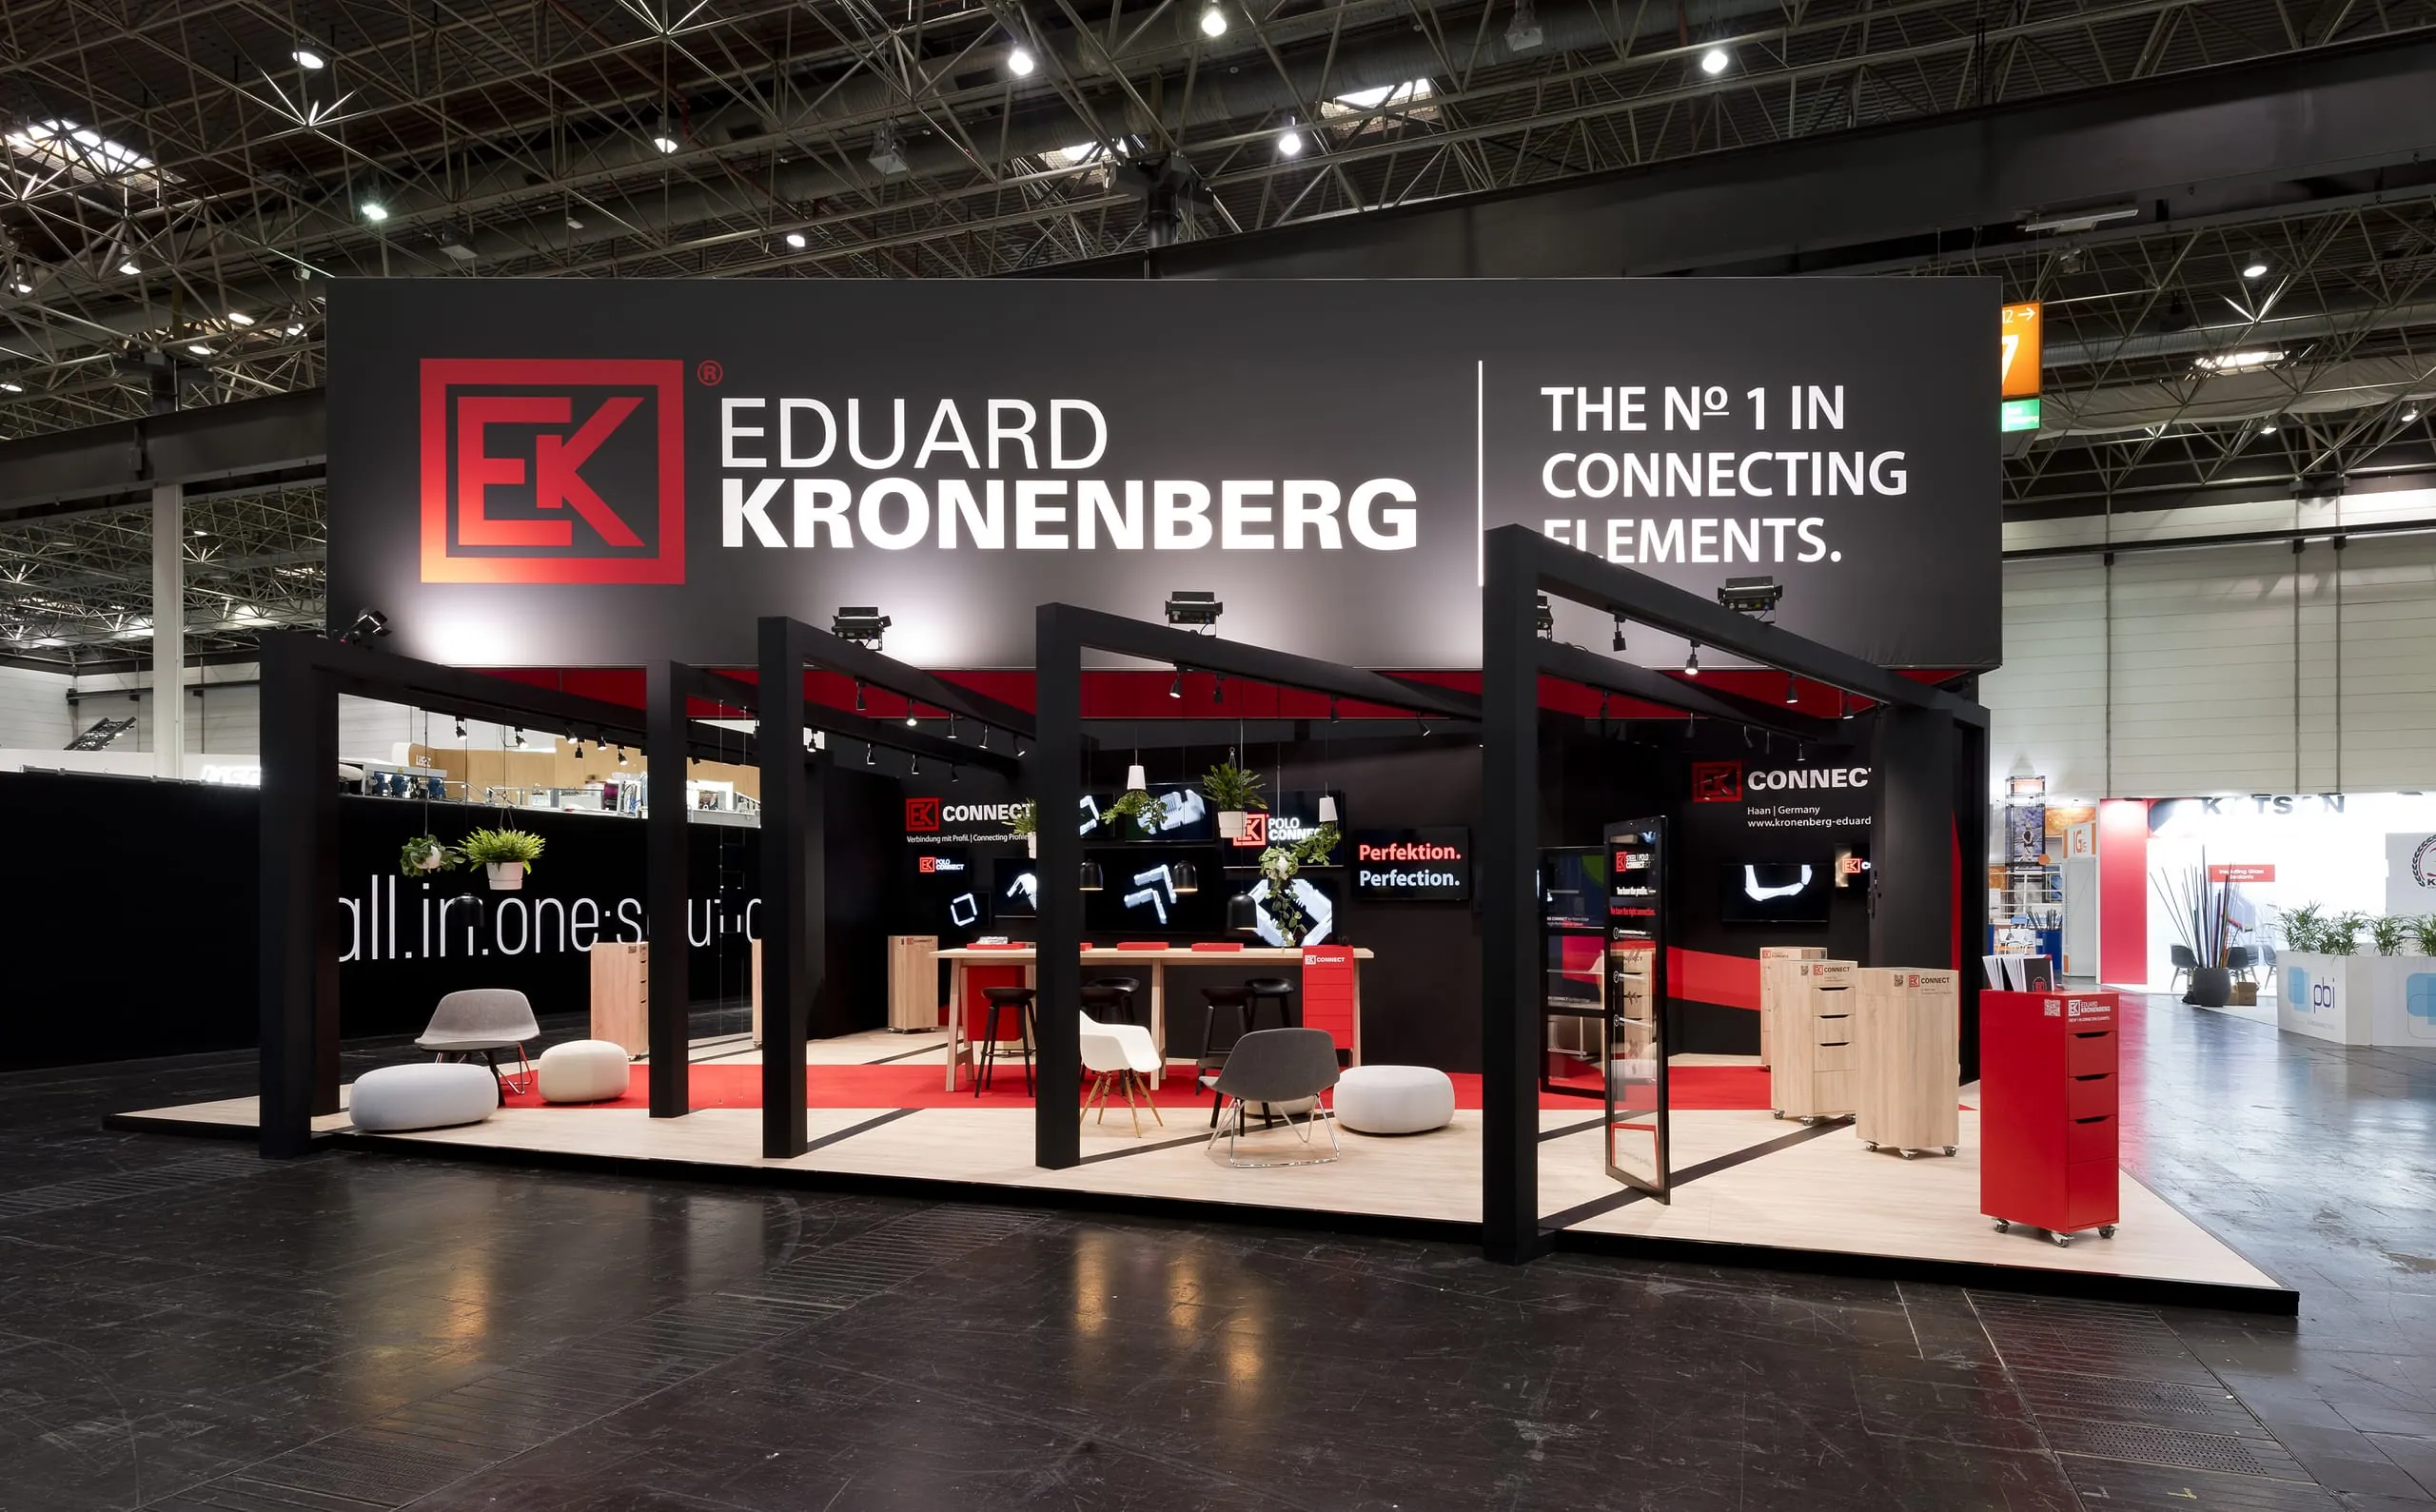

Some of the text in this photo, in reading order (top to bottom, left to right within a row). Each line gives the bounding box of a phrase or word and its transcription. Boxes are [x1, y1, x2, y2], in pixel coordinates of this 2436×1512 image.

[1541, 386, 1647, 431] THE
[1747, 386, 1765, 430] 1
[1792, 384, 1844, 430] IN
[721, 398, 1108, 469] EDUARD
[458, 396, 645, 546] EK
[1542, 450, 1908, 499] CONNECTING
[722, 477, 1417, 551] KRONENBERG
[1747, 767, 1872, 791] CONNEC
[1747, 806, 1771, 815] Haan
[1778, 805, 1820, 816] Germany
[2201, 794, 2346, 815] KTSN
[1267, 817, 1300, 829] POLO
[907, 835, 941, 844] Verbindung
[972, 834, 1008, 843] Connecting
[1359, 842, 1462, 861] Perfektion.
[1359, 869, 1461, 887] Perfection.
[2313, 976, 2335, 1014] pbi
